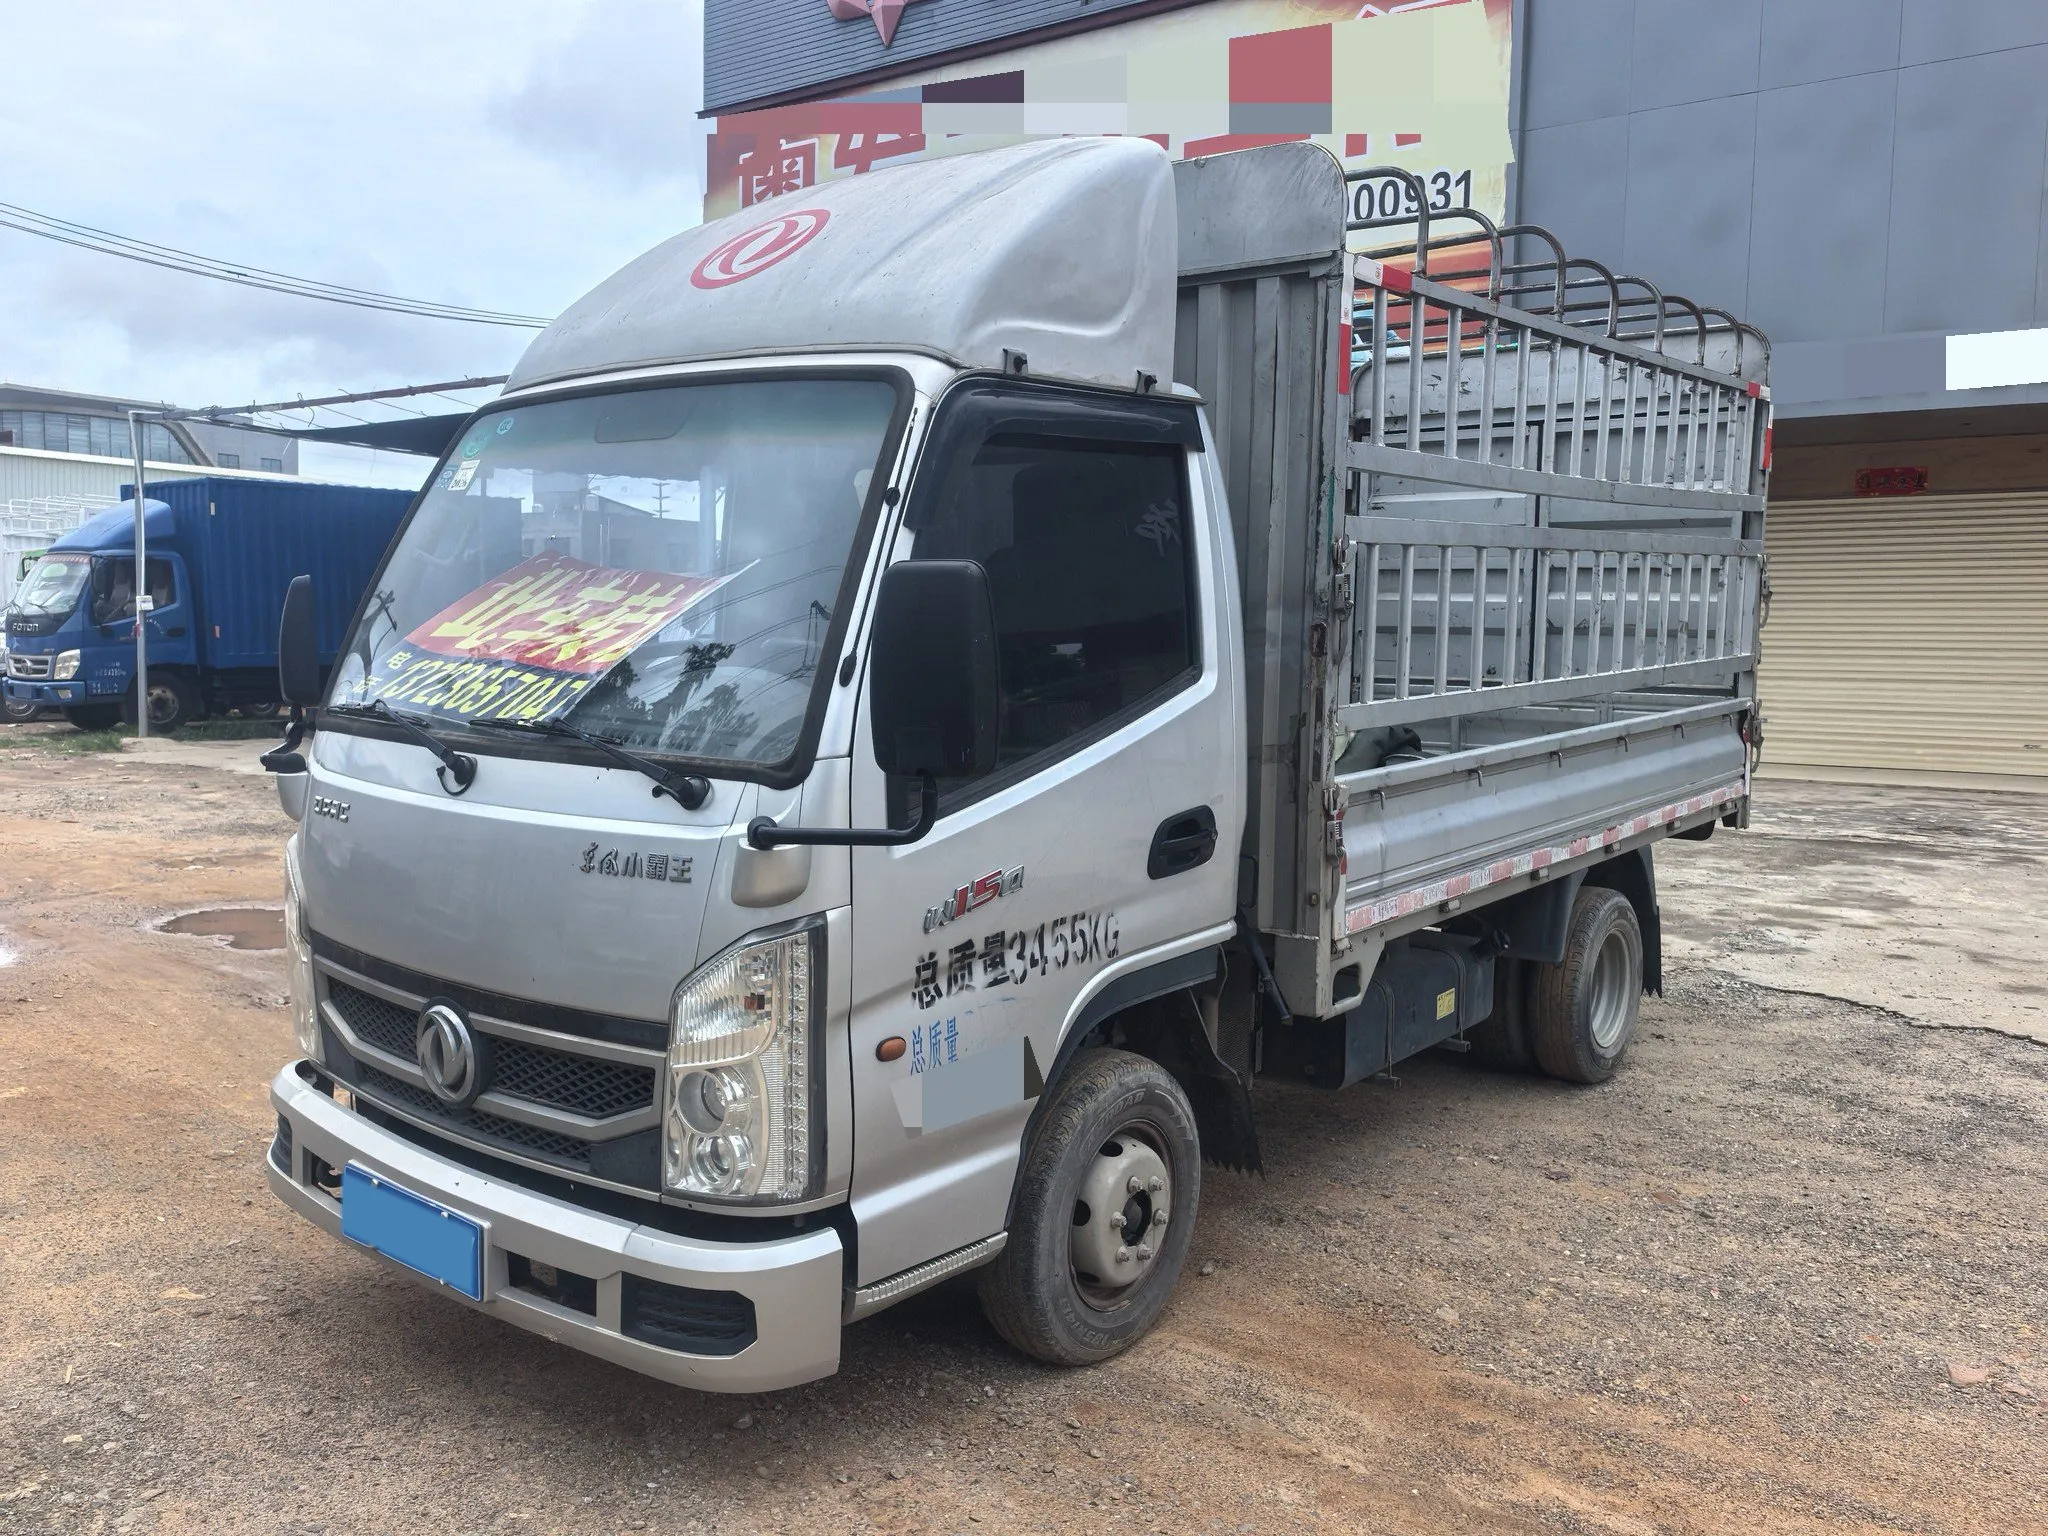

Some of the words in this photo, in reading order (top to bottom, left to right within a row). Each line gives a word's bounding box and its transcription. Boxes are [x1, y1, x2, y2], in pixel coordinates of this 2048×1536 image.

[12, 622, 39, 632] FOTON
[911, 911, 1120, 1010] 总质量3455KG
[910, 1016, 959, 1076] 总质量
